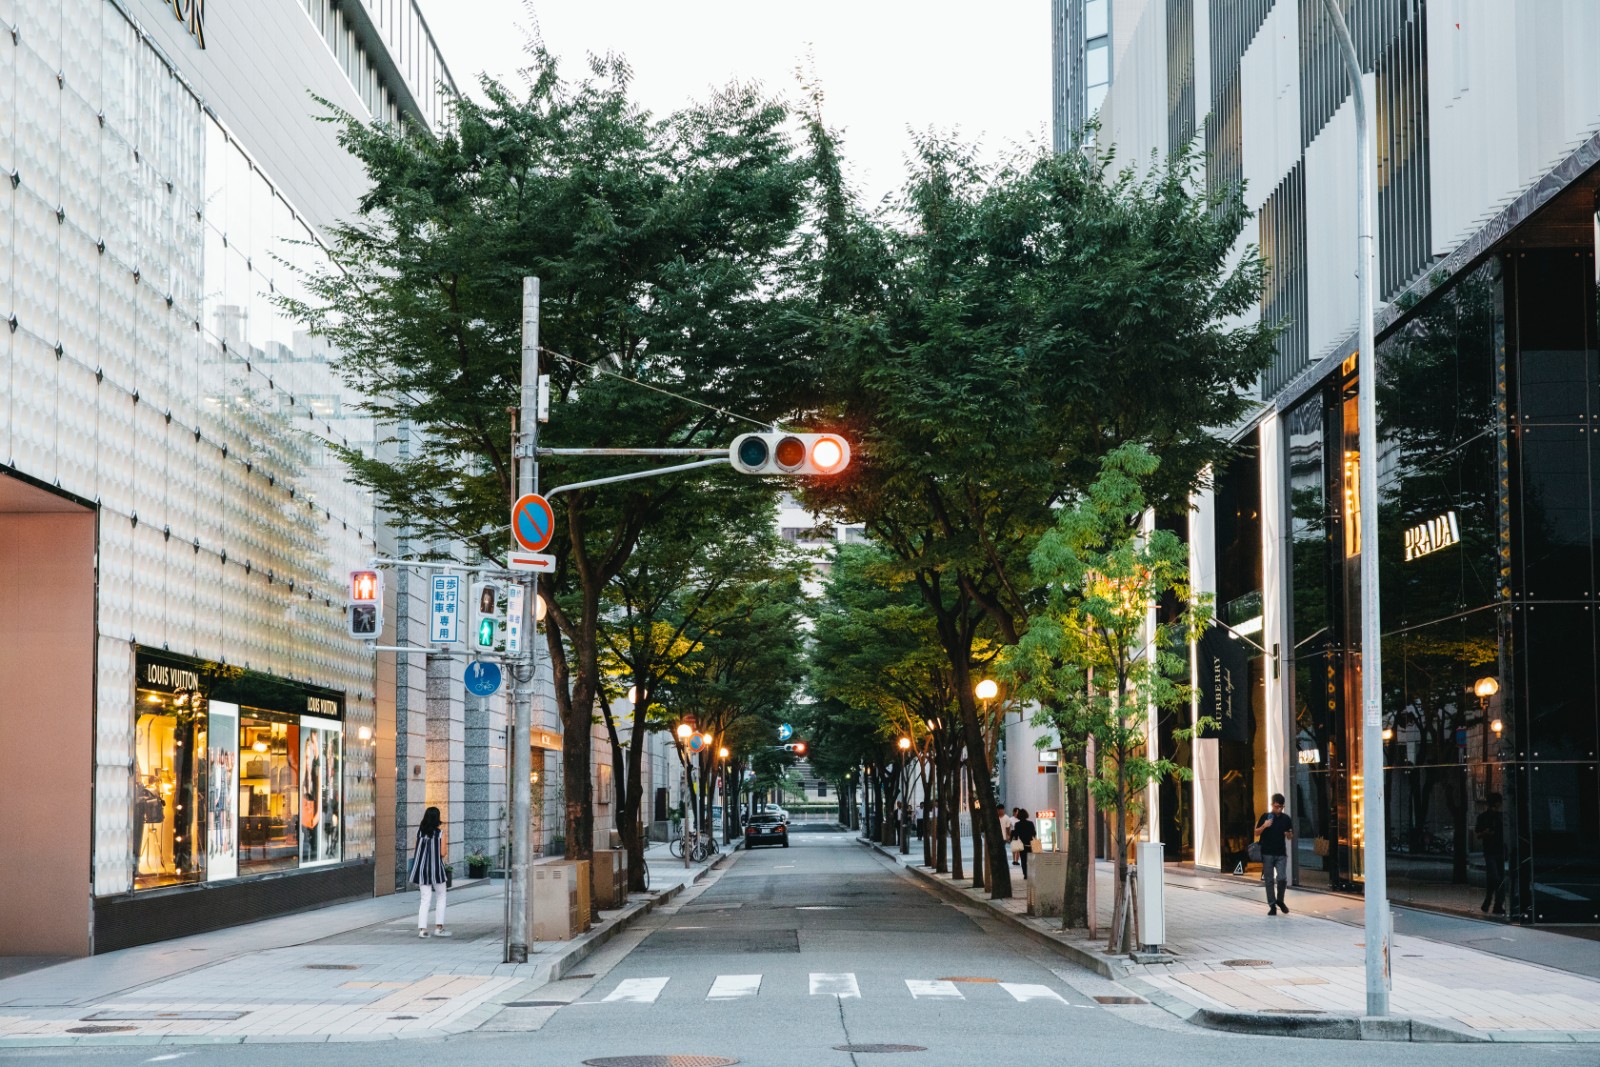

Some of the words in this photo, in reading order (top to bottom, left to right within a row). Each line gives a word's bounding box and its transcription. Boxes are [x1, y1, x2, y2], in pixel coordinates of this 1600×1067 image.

[1405, 511, 1460, 561] PRADA
[435, 580, 444, 613] 自転車
[446, 579, 456, 613] 歩行者
[440, 616, 449, 639] 専用
[148, 664, 168, 685] LOUIS
[170, 668, 198, 691] VUITTON
[307, 696, 319, 712] LOUIS
[320, 699, 337, 715] VUITTON
[1040, 819, 1052, 834] P
